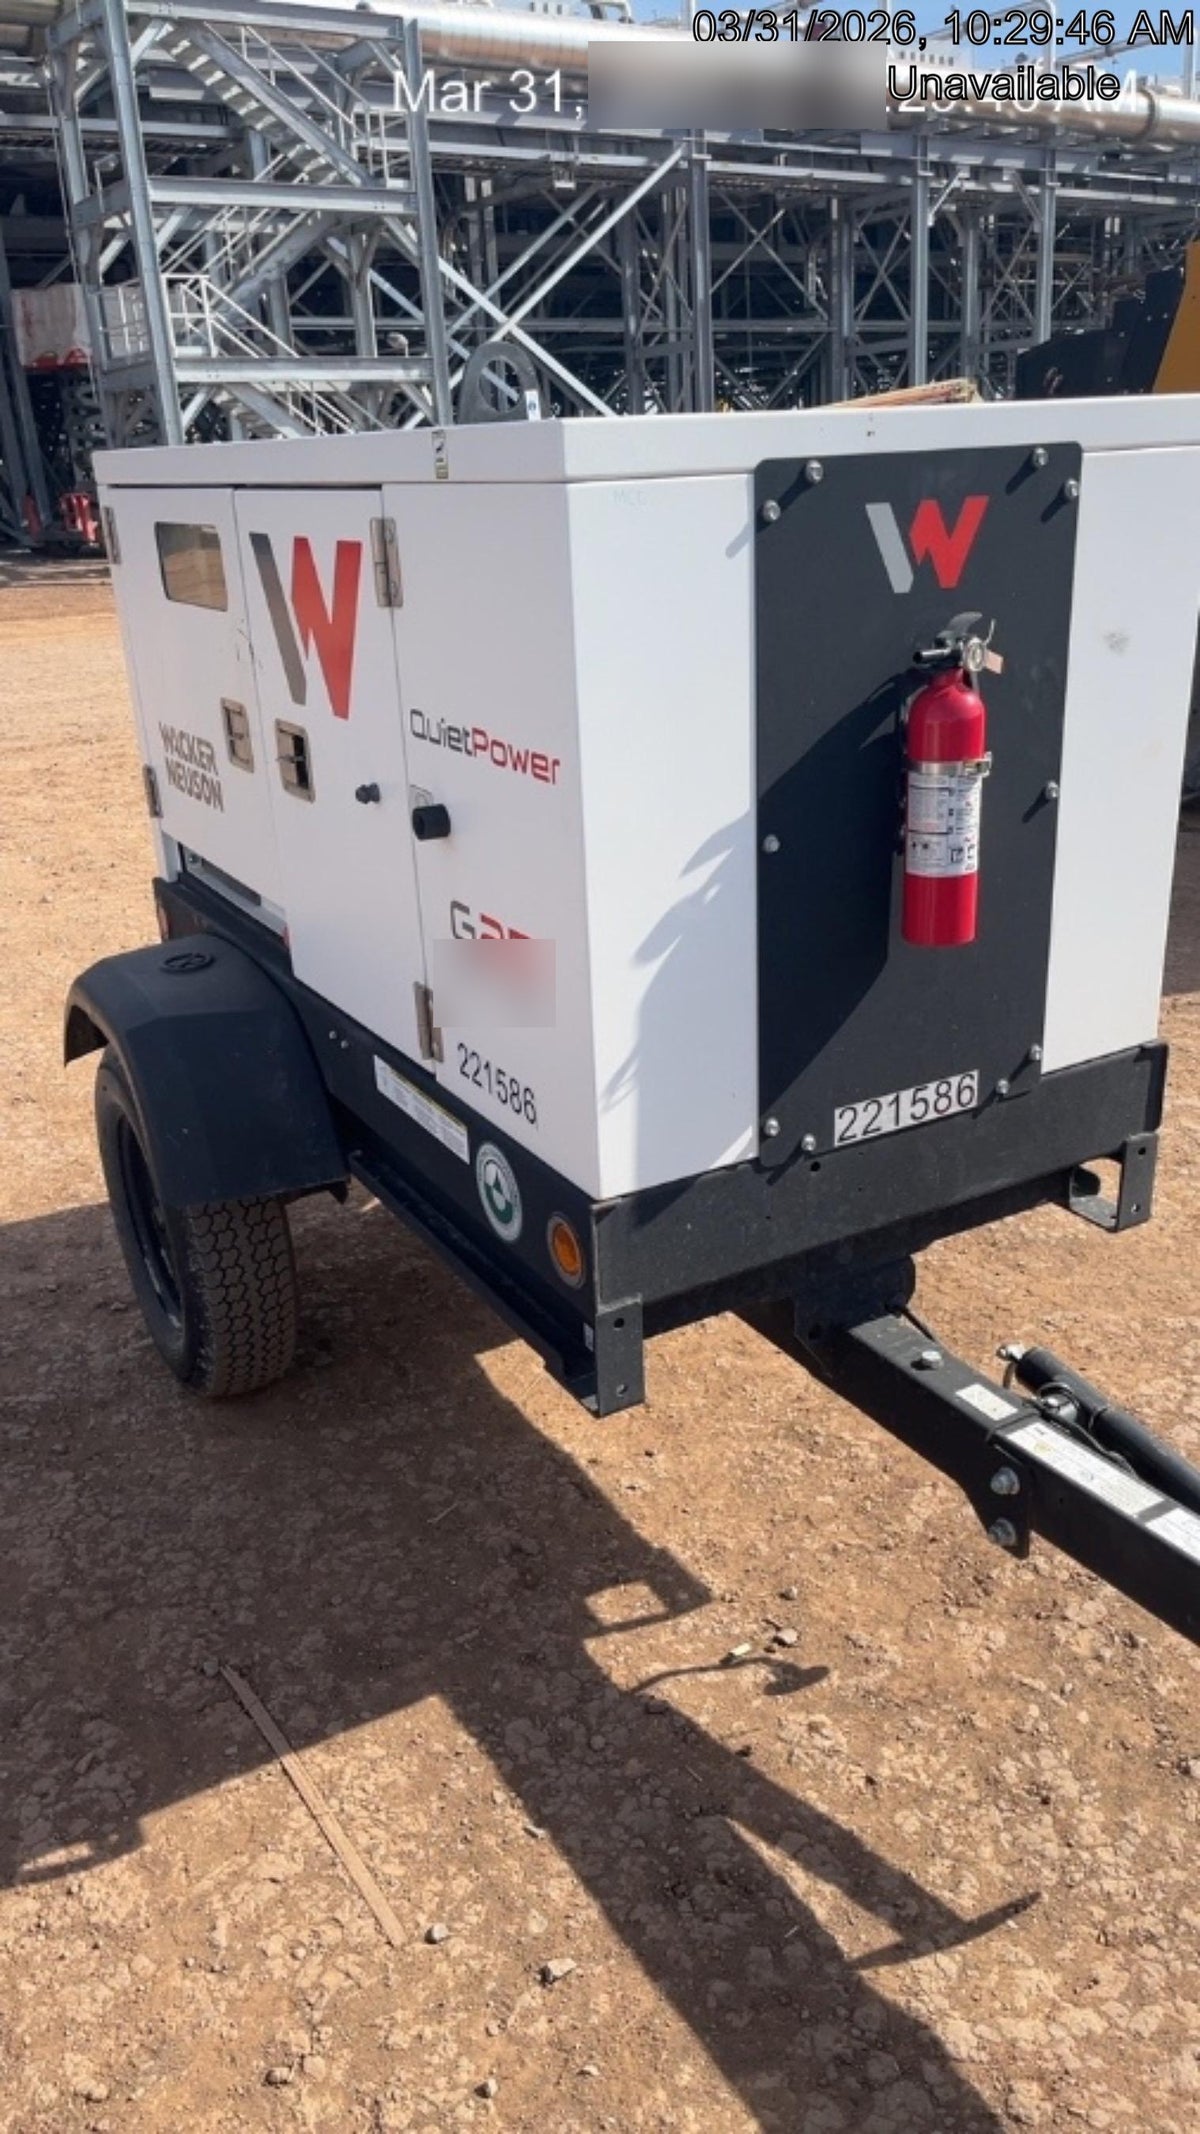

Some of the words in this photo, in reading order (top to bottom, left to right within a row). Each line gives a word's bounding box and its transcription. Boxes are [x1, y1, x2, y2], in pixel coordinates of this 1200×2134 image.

[159, 720, 219, 777] WACKER
[410, 708, 560, 785] QuietPower
[164, 756, 224, 813] NEUSON
[457, 1042, 537, 1125] 221586
[838, 1073, 976, 1142] 221586
